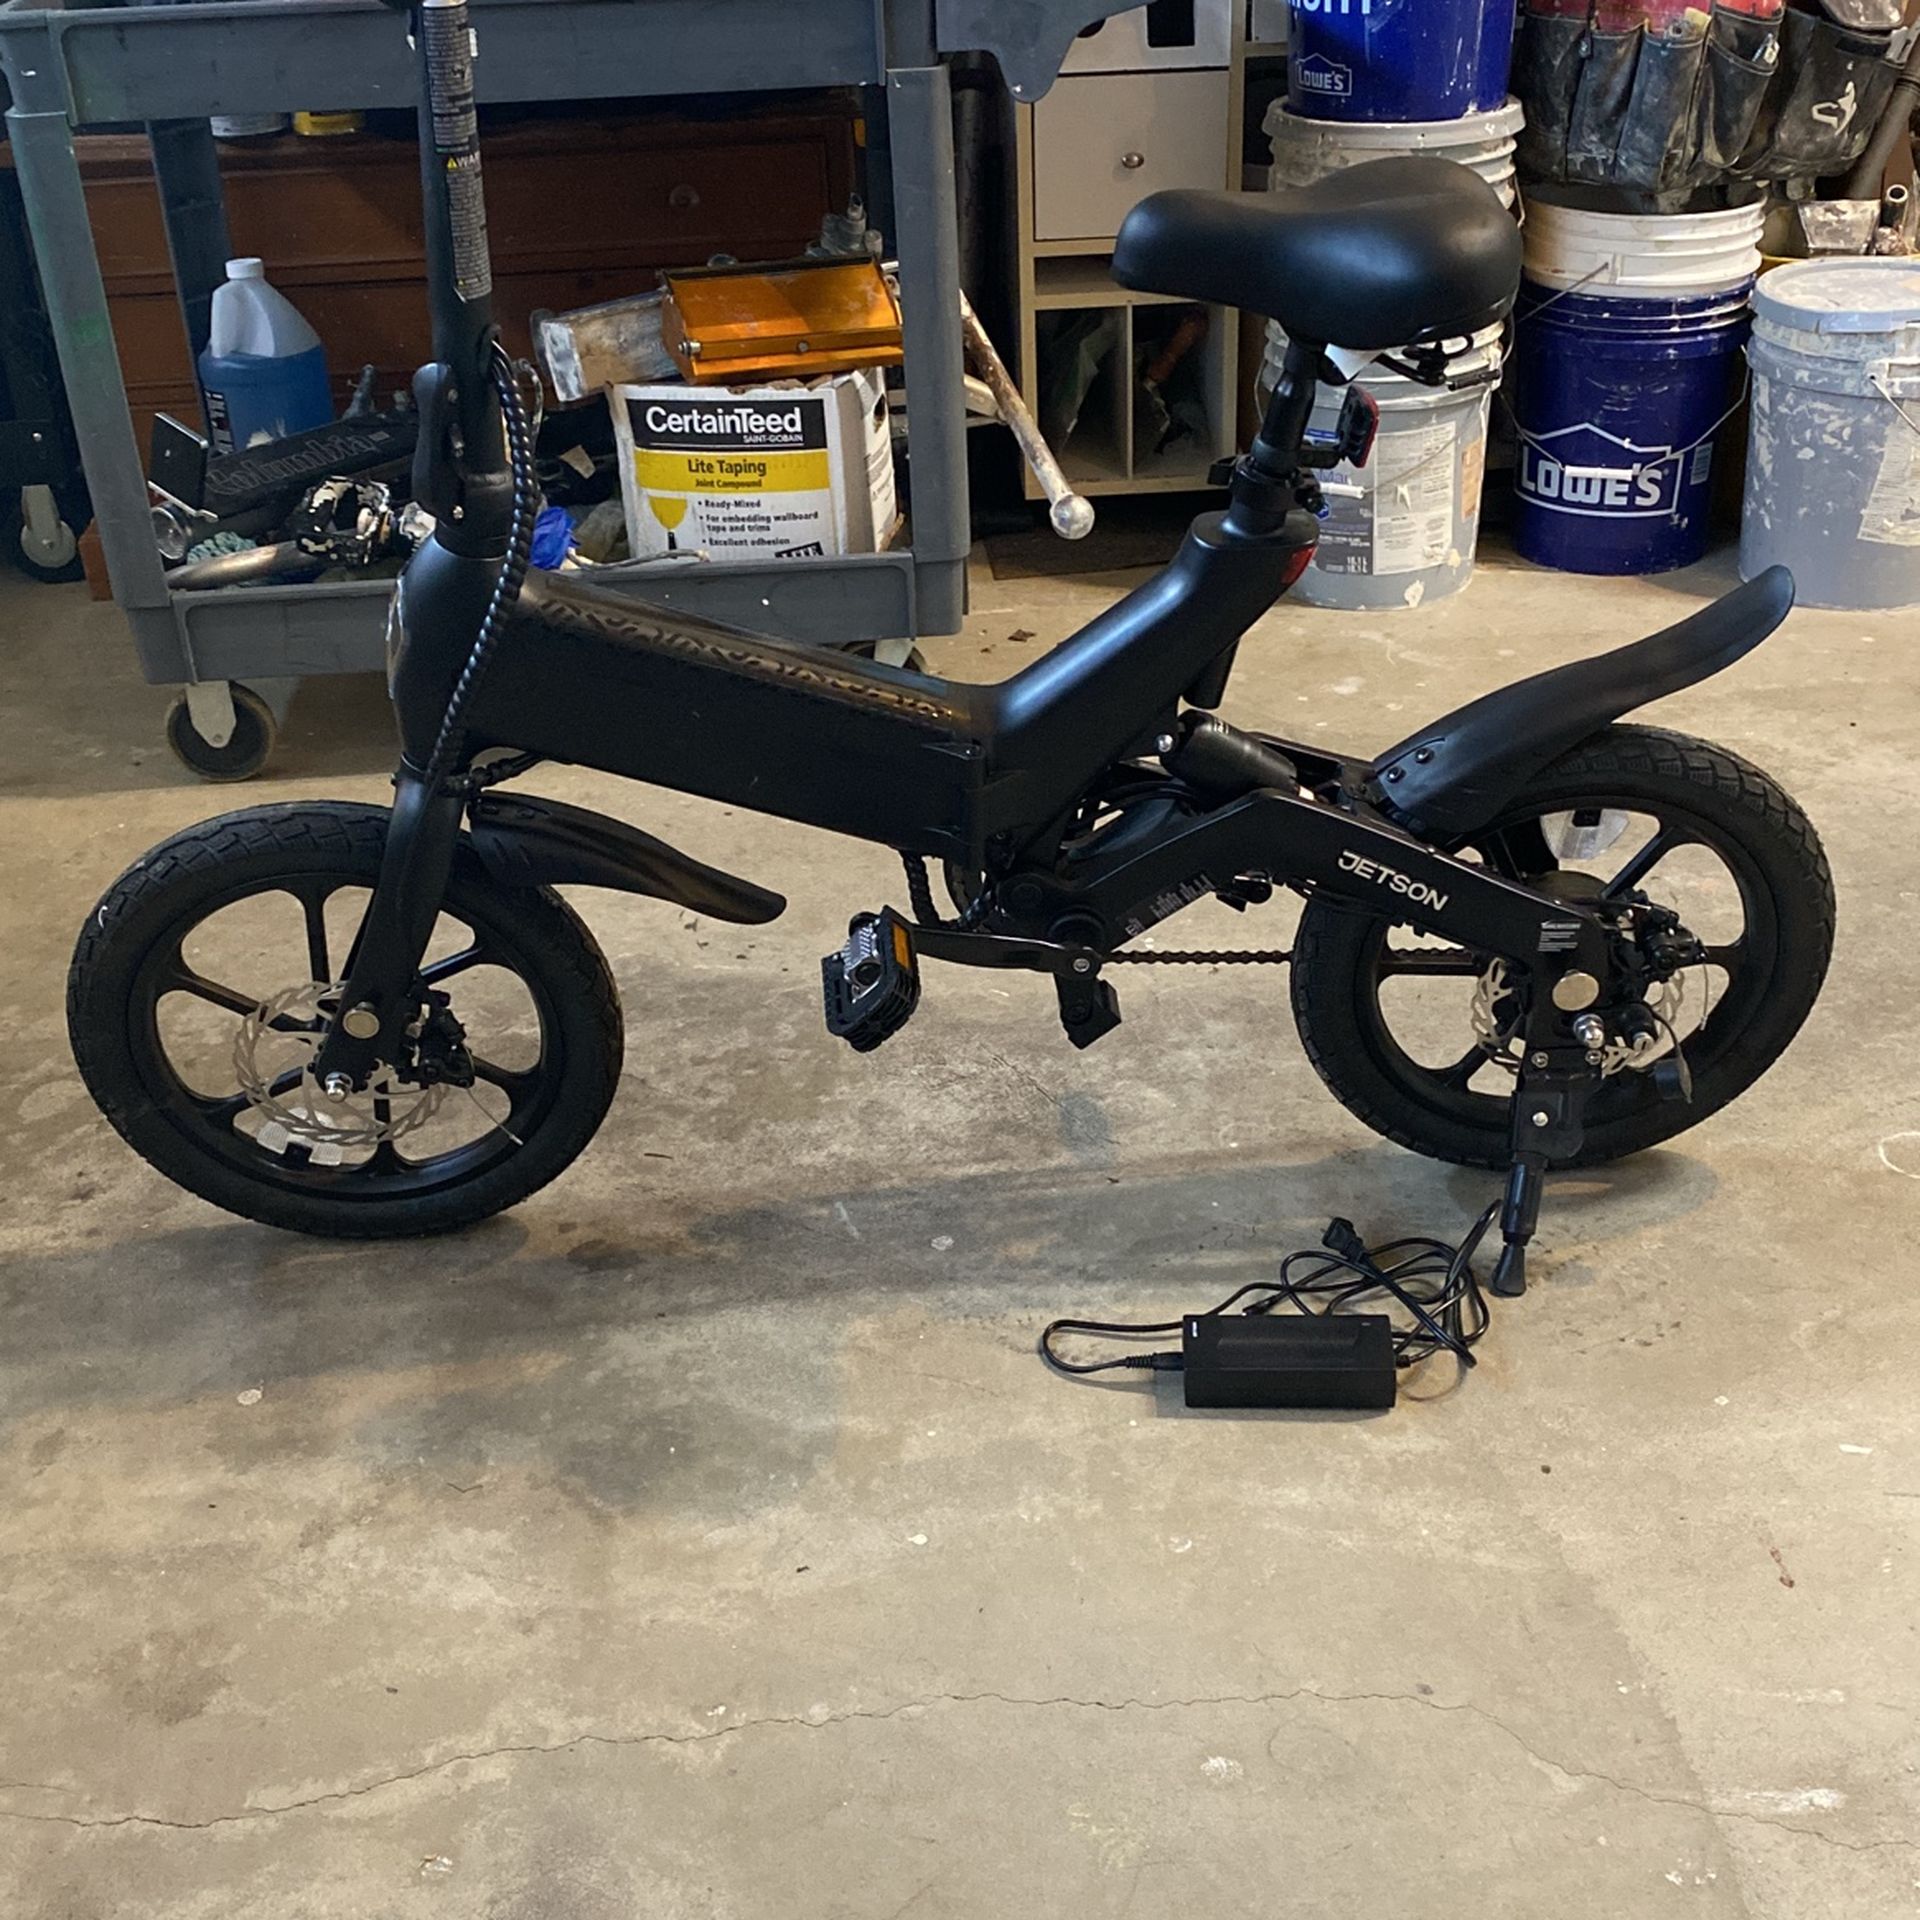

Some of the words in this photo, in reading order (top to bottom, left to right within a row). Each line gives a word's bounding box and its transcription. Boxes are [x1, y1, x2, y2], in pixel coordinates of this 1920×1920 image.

[1299, 65, 1344, 91] LOWE'S
[645, 406, 803, 434] CertainTeed
[743, 434, 803, 443] SAINT-GOBAIN
[204, 433, 377, 496] Columbia
[687, 459, 714, 473] Lite
[716, 459, 767, 477] Taping
[695, 479, 715, 488] Joint
[716, 479, 762, 489] Compound
[1521, 445, 1664, 508] LOWE'S
[704, 499, 761, 510] Ready-Mixed
[705, 514, 719, 522] For
[721, 514, 771, 523] embedding
[773, 511, 818, 521] wallboard
[706, 524, 726, 533] tape
[728, 524, 746, 532] and
[747, 523, 770, 532] trims
[708, 538, 748, 546] Excellent
[750, 537, 790, 545] adhesion
[1337, 850, 1449, 912] JETSON
